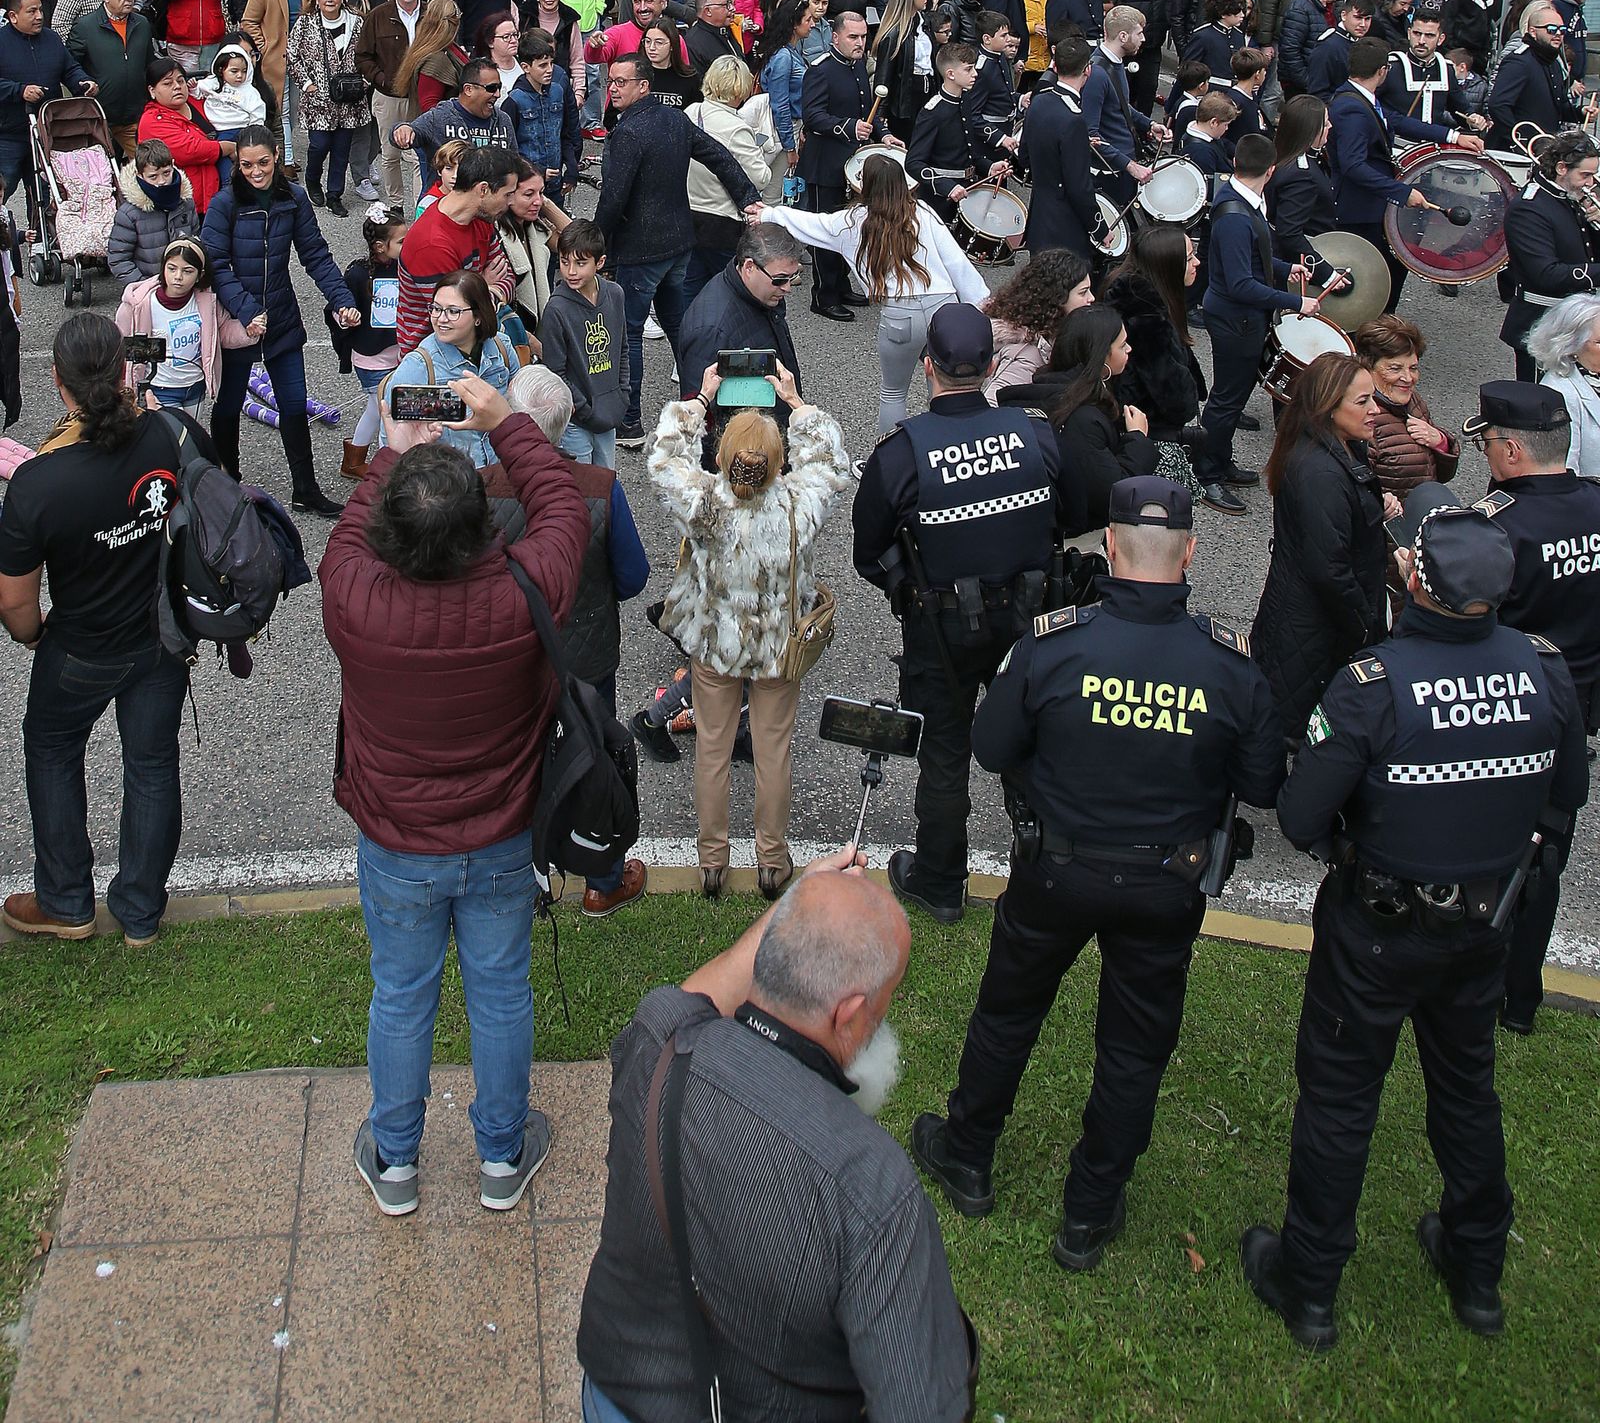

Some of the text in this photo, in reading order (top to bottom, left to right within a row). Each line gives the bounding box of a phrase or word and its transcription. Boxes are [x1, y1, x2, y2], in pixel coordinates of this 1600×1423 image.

[589, 350, 609, 366] PLAY
[589, 360, 612, 375] AGAIN
[927, 432, 1025, 468] POLICIA
[941, 452, 1020, 484] LOCAL
[94, 519, 136, 542] Turismo
[107, 518, 164, 550] Running
[1081, 674, 1208, 713] POLICIA
[1411, 671, 1537, 706] POLICIA
[1091, 701, 1193, 735] LOCAL
[1430, 698, 1531, 730] LOCAL
[746, 1016, 779, 1042] SONY
